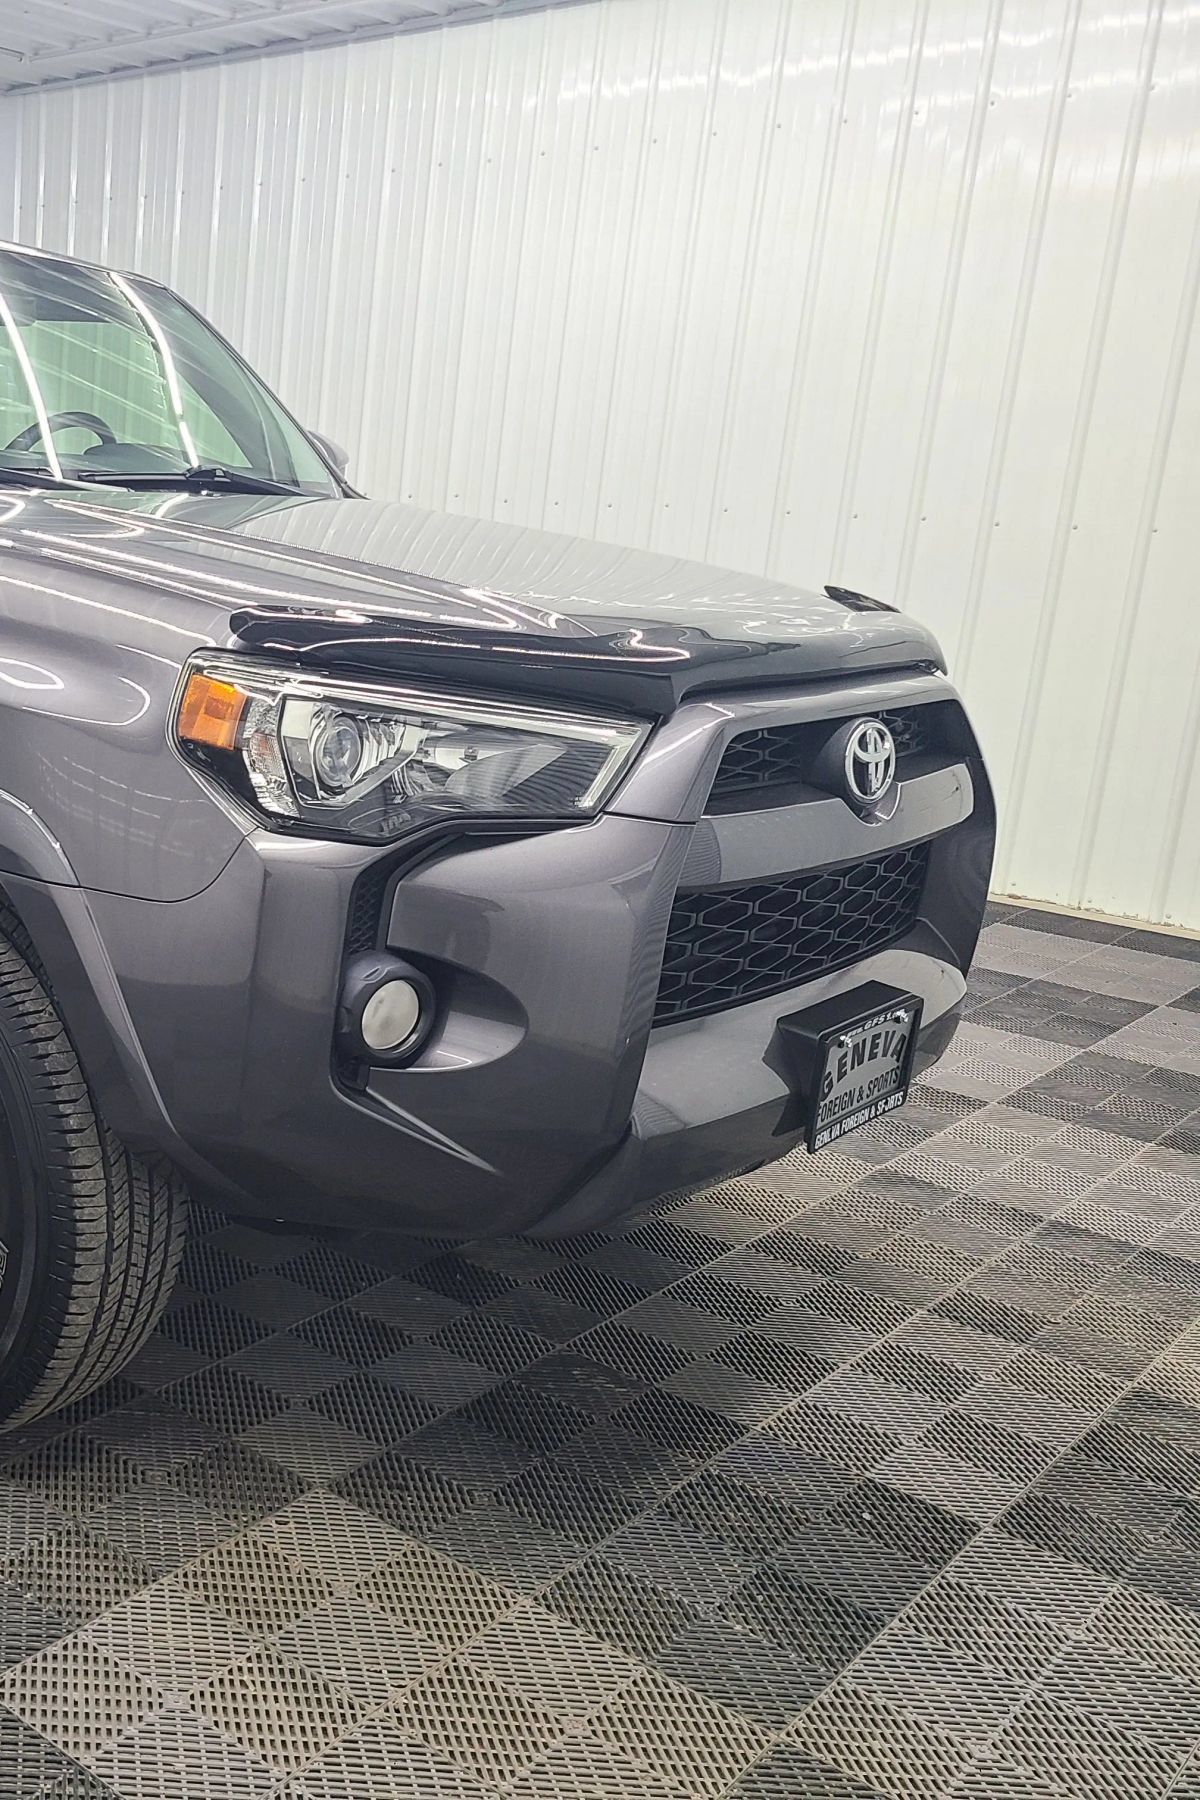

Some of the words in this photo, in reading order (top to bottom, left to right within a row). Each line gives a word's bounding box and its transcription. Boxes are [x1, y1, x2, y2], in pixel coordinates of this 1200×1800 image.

[821, 1030, 907, 1101] GENEVA
[856, 1085, 865, 1104] &
[866, 1065, 900, 1099] SPORTS
[841, 1107, 870, 1135] FOREIGN
[869, 1105, 876, 1119] &
